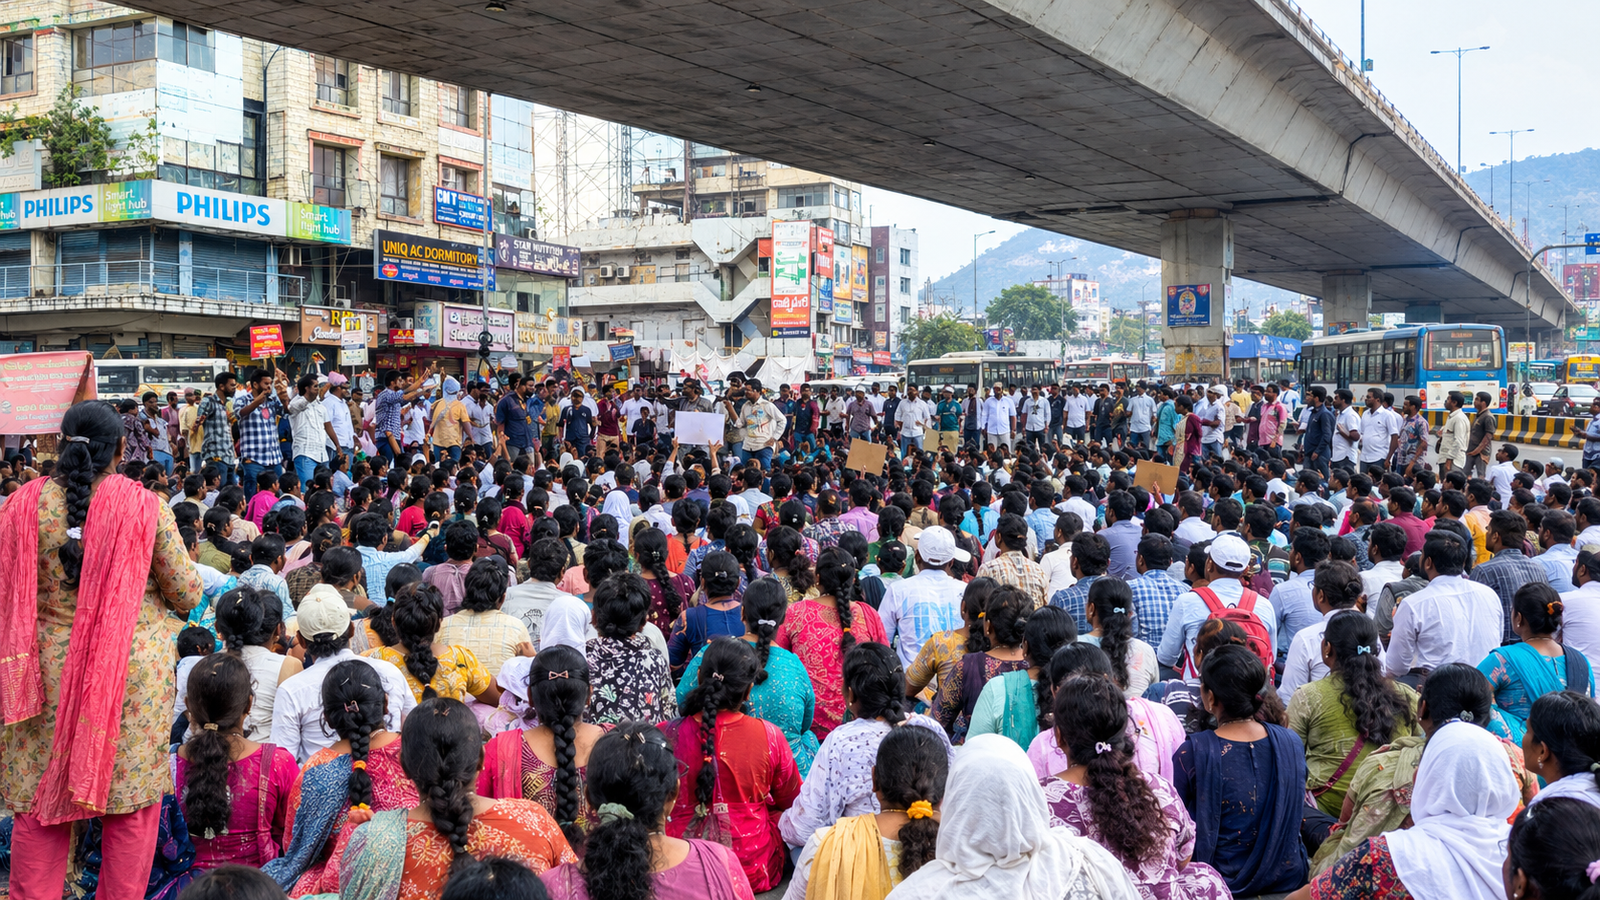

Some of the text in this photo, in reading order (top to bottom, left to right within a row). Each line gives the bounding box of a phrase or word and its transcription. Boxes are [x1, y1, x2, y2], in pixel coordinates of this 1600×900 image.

[105, 188, 135, 201] Smart
[24, 194, 93, 219] PHILIPS
[128, 197, 147, 209] hub
[177, 191, 271, 227] PHILIPS
[300, 208, 329, 222] Smart
[323, 222, 340, 235] hub
[382, 240, 408, 257] UNIQ
[409, 244, 424, 258] AC
[424, 246, 478, 266] DORMITORY
